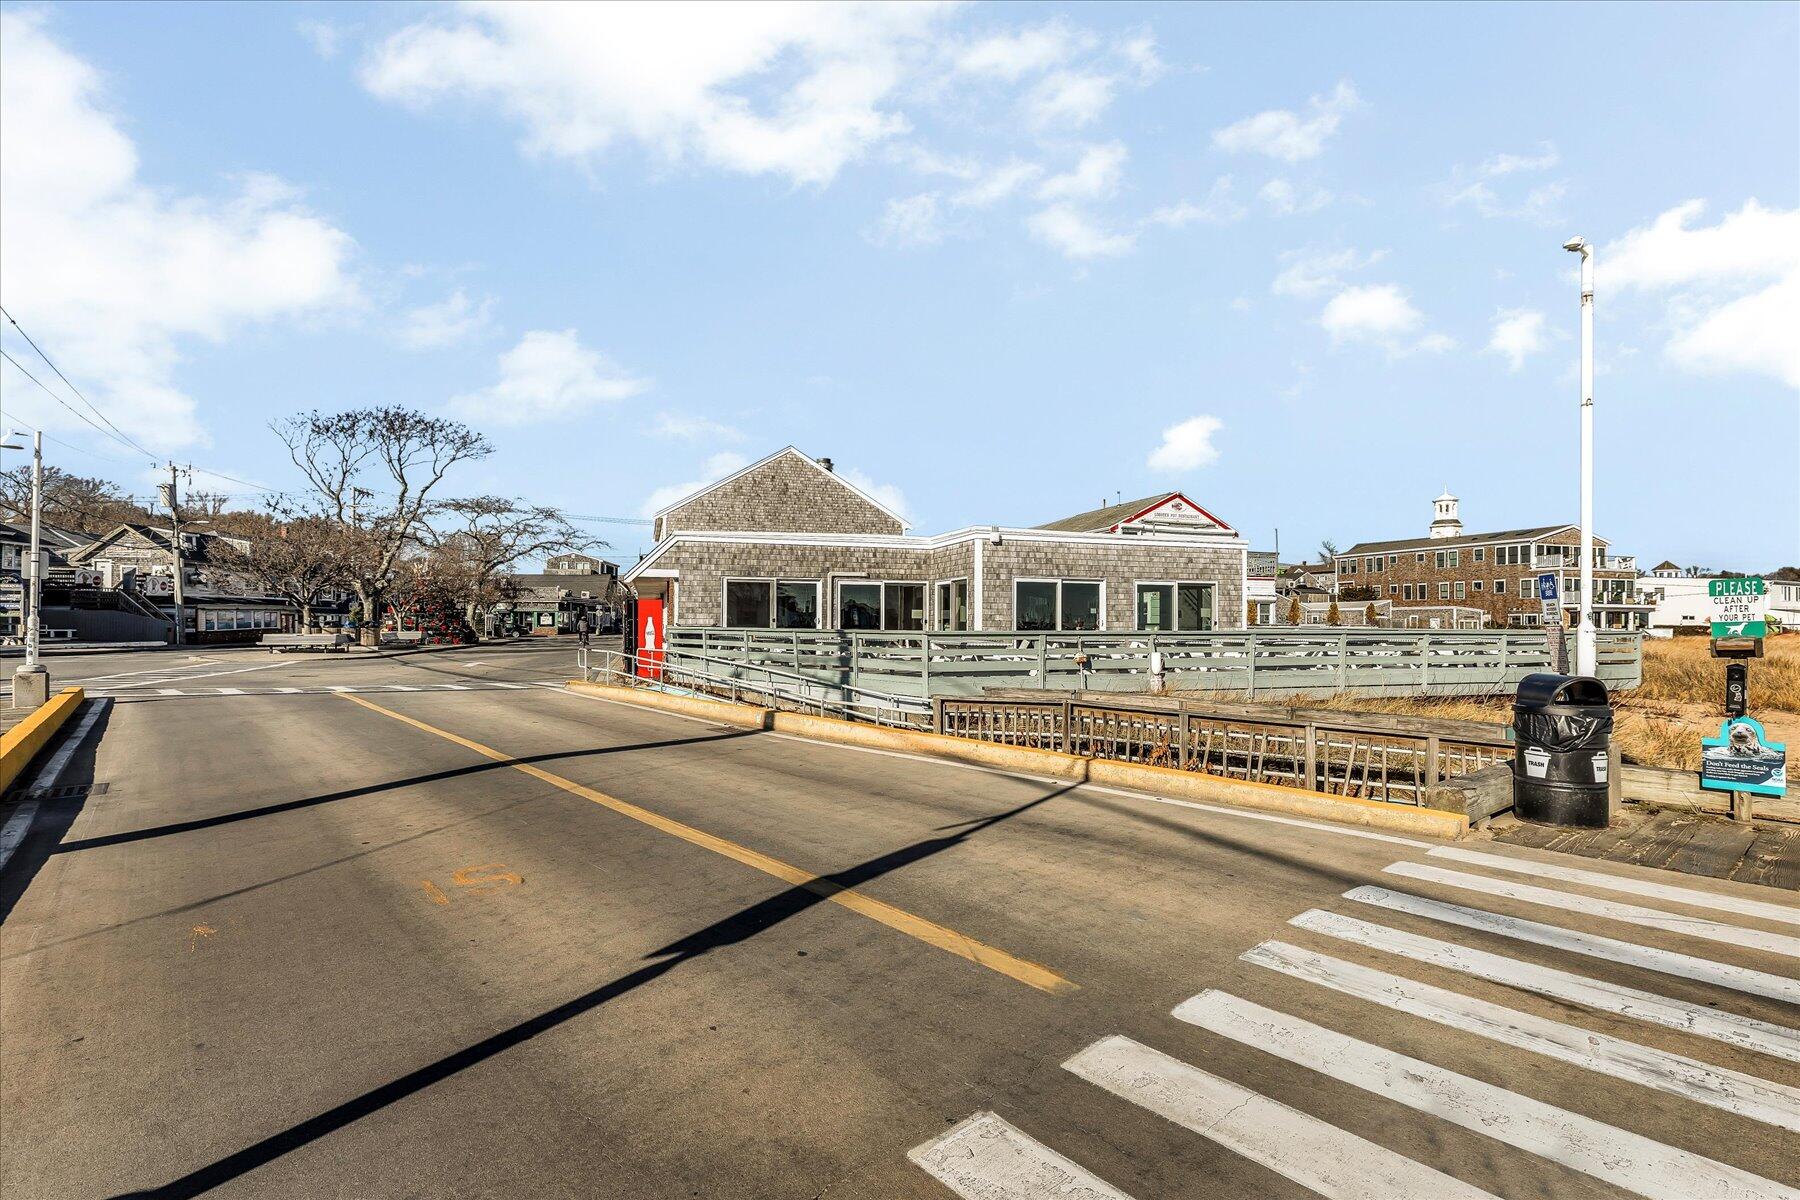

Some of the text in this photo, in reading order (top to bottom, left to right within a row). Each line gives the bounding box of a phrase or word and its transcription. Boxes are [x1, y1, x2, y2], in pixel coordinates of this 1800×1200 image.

[1716, 581, 1757, 595] PLEASE
[1713, 596, 1759, 605] CLEAN UP
[1724, 605, 1749, 613] AFTER
[1742, 613, 1756, 621] PET
[1528, 760, 1545, 768] TRASH
